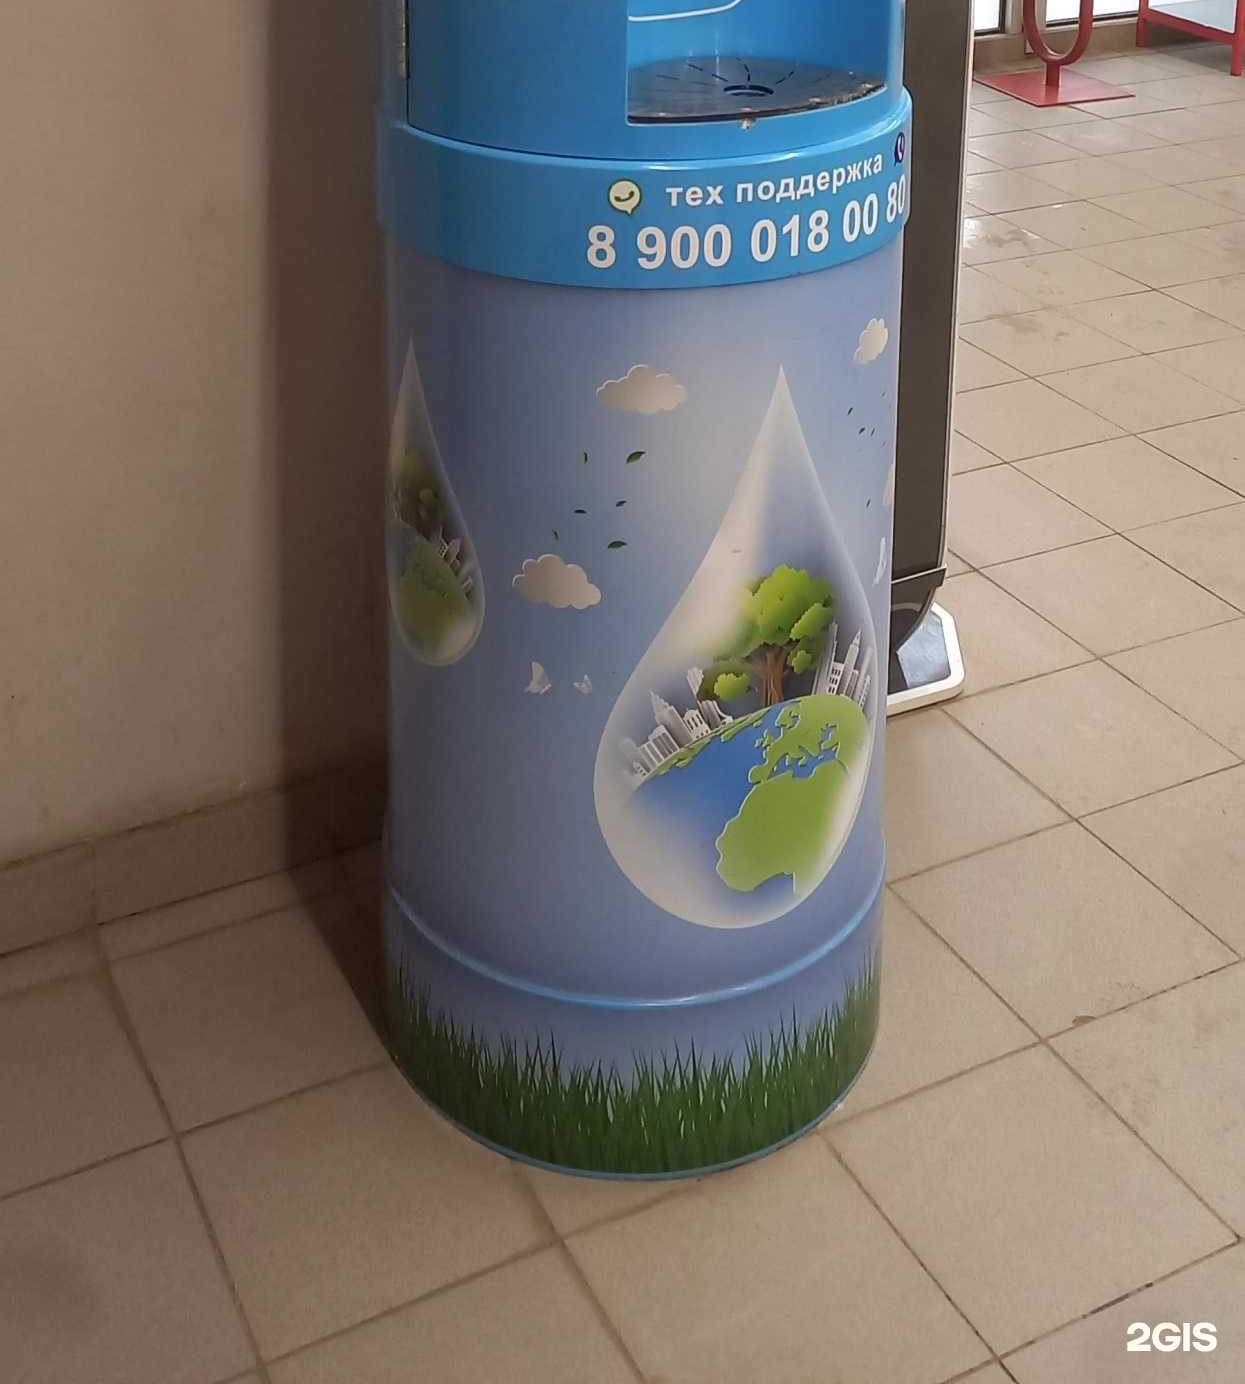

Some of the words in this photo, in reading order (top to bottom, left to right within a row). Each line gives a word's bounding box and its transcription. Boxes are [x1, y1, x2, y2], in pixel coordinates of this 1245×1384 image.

[666, 185, 724, 206] тех
[736, 153, 883, 203] поддержка
[586, 225, 616, 268] 8
[637, 224, 732, 269] 900
[751, 209, 829, 263] 018
[842, 193, 878, 243] 00
[886, 174, 906, 223] 80
